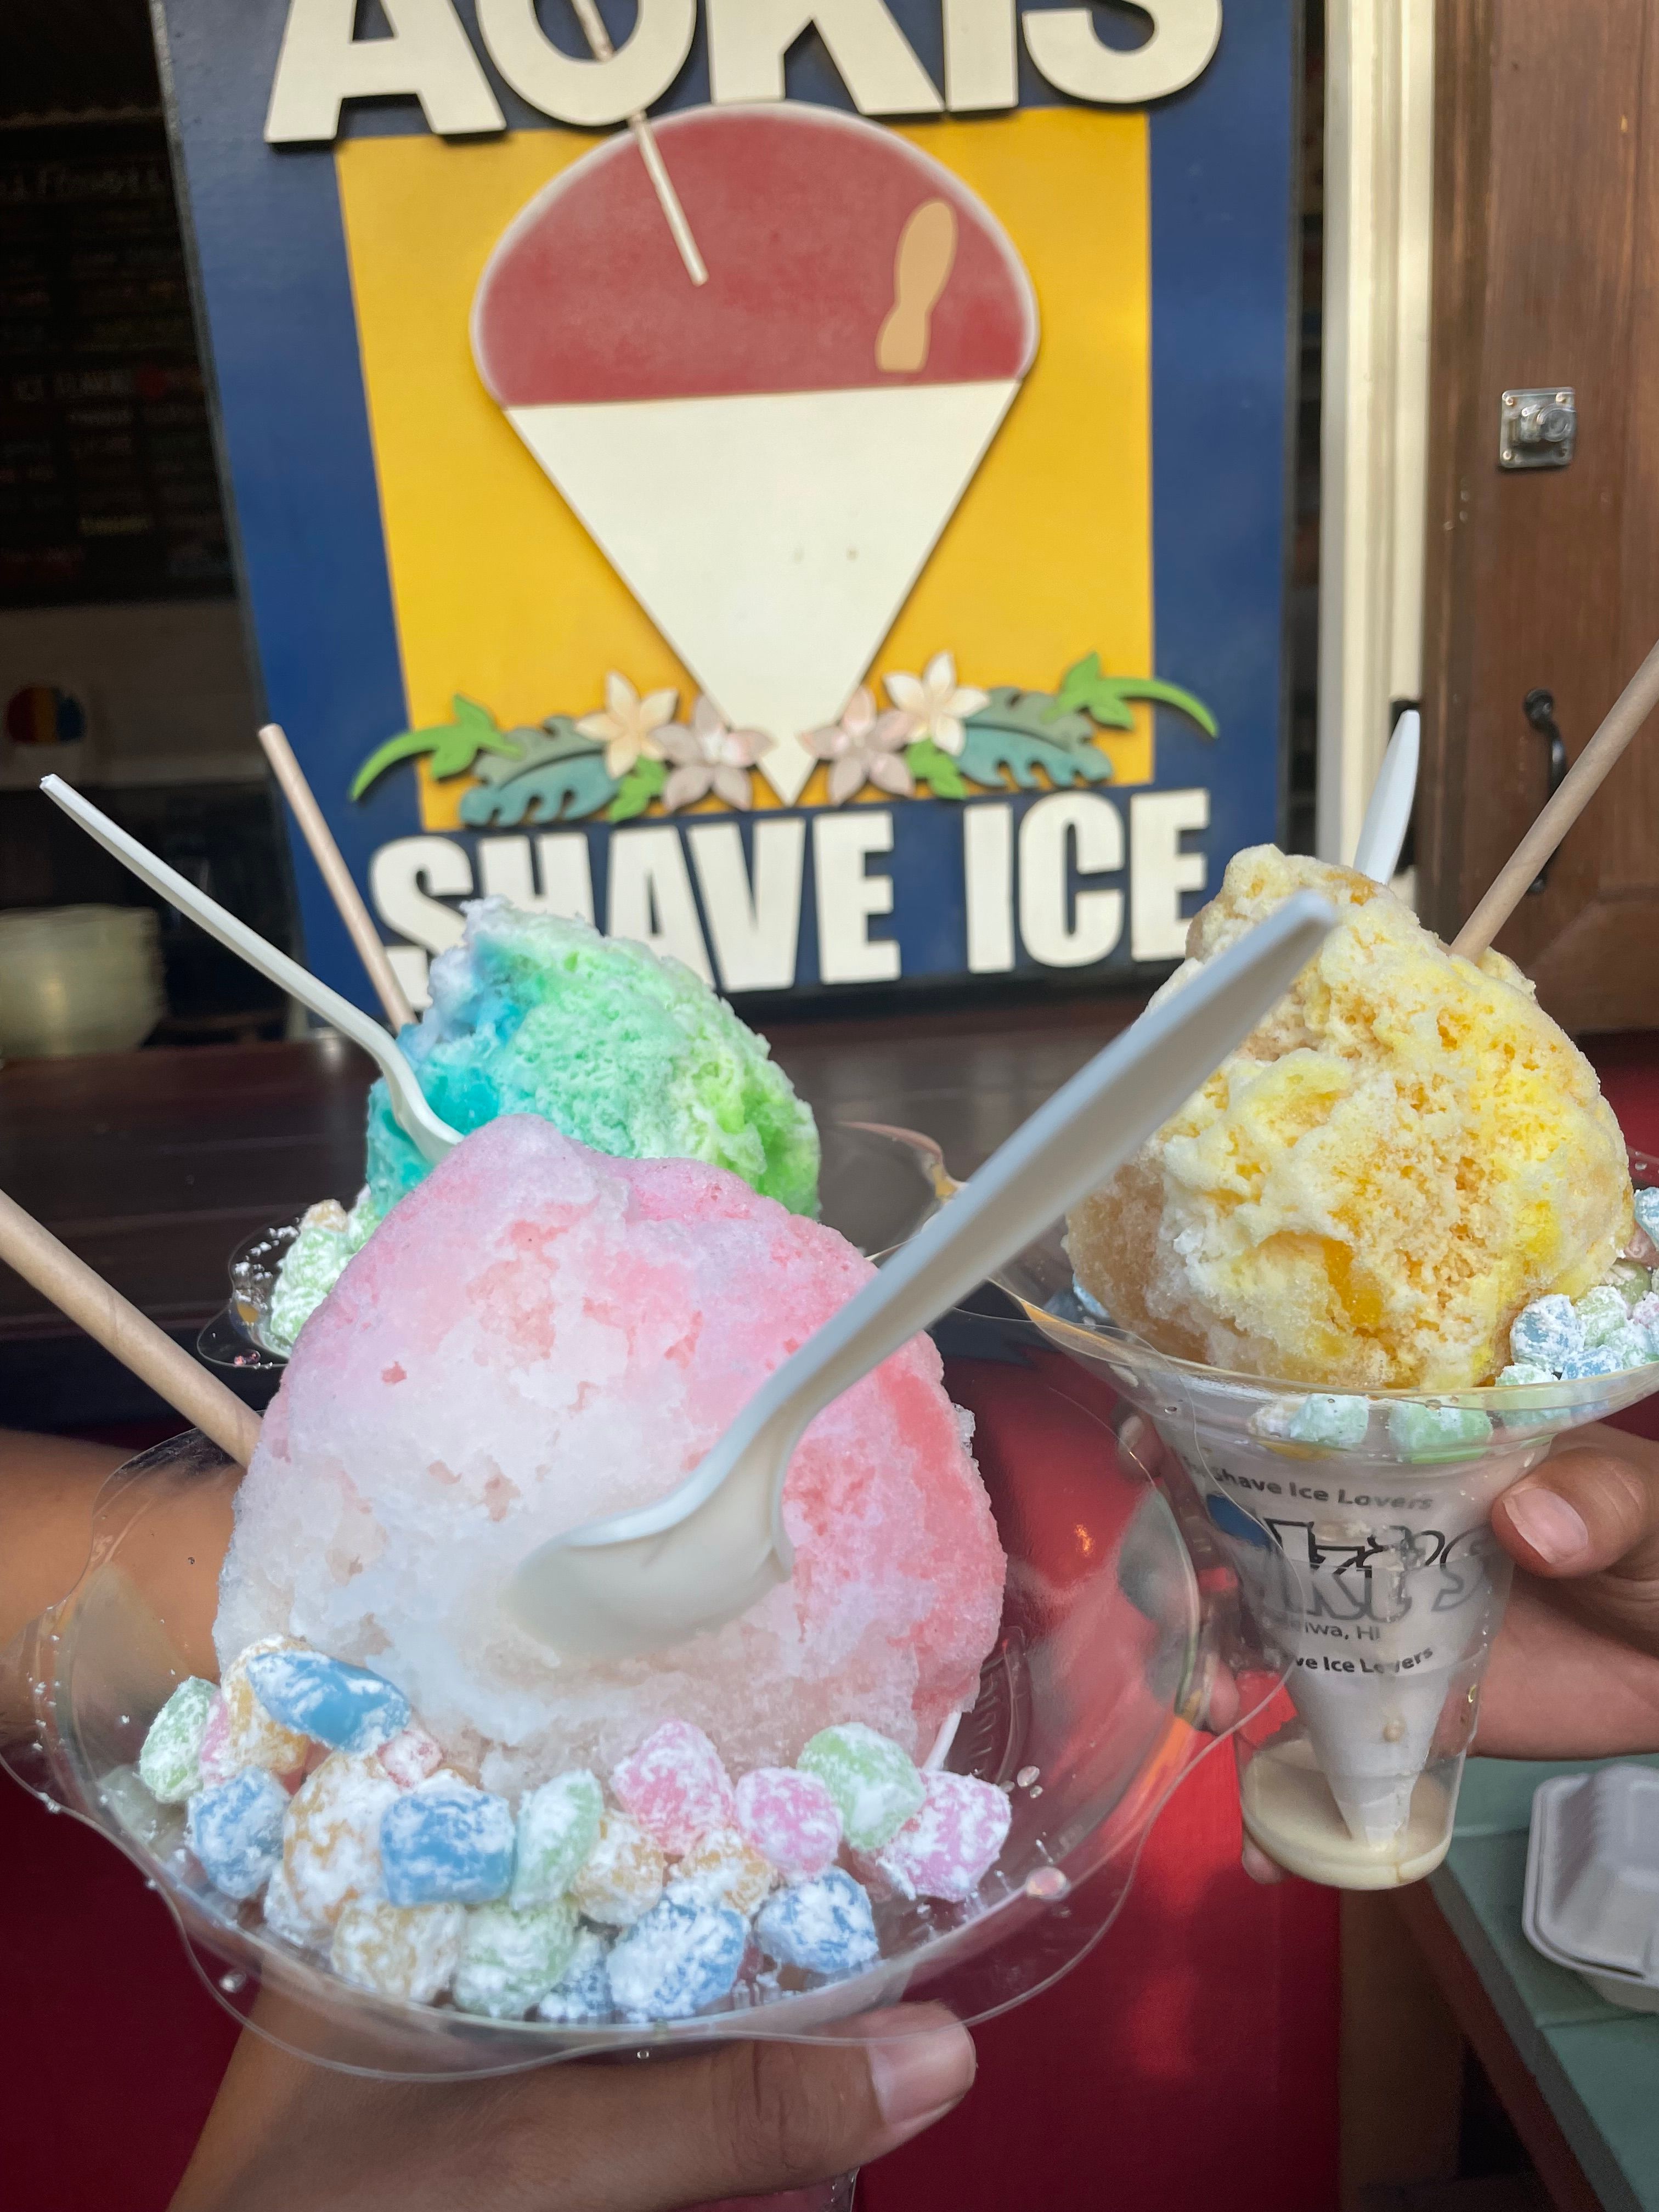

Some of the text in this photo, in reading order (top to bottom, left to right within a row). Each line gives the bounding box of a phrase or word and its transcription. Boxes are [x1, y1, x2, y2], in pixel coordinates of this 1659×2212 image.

[964, 788, 1211, 973] ICE
[1289, 1482, 1329, 1502] Ice
[1338, 1488, 1434, 1510] Lovers
[1323, 1656, 1355, 1673] Ice
